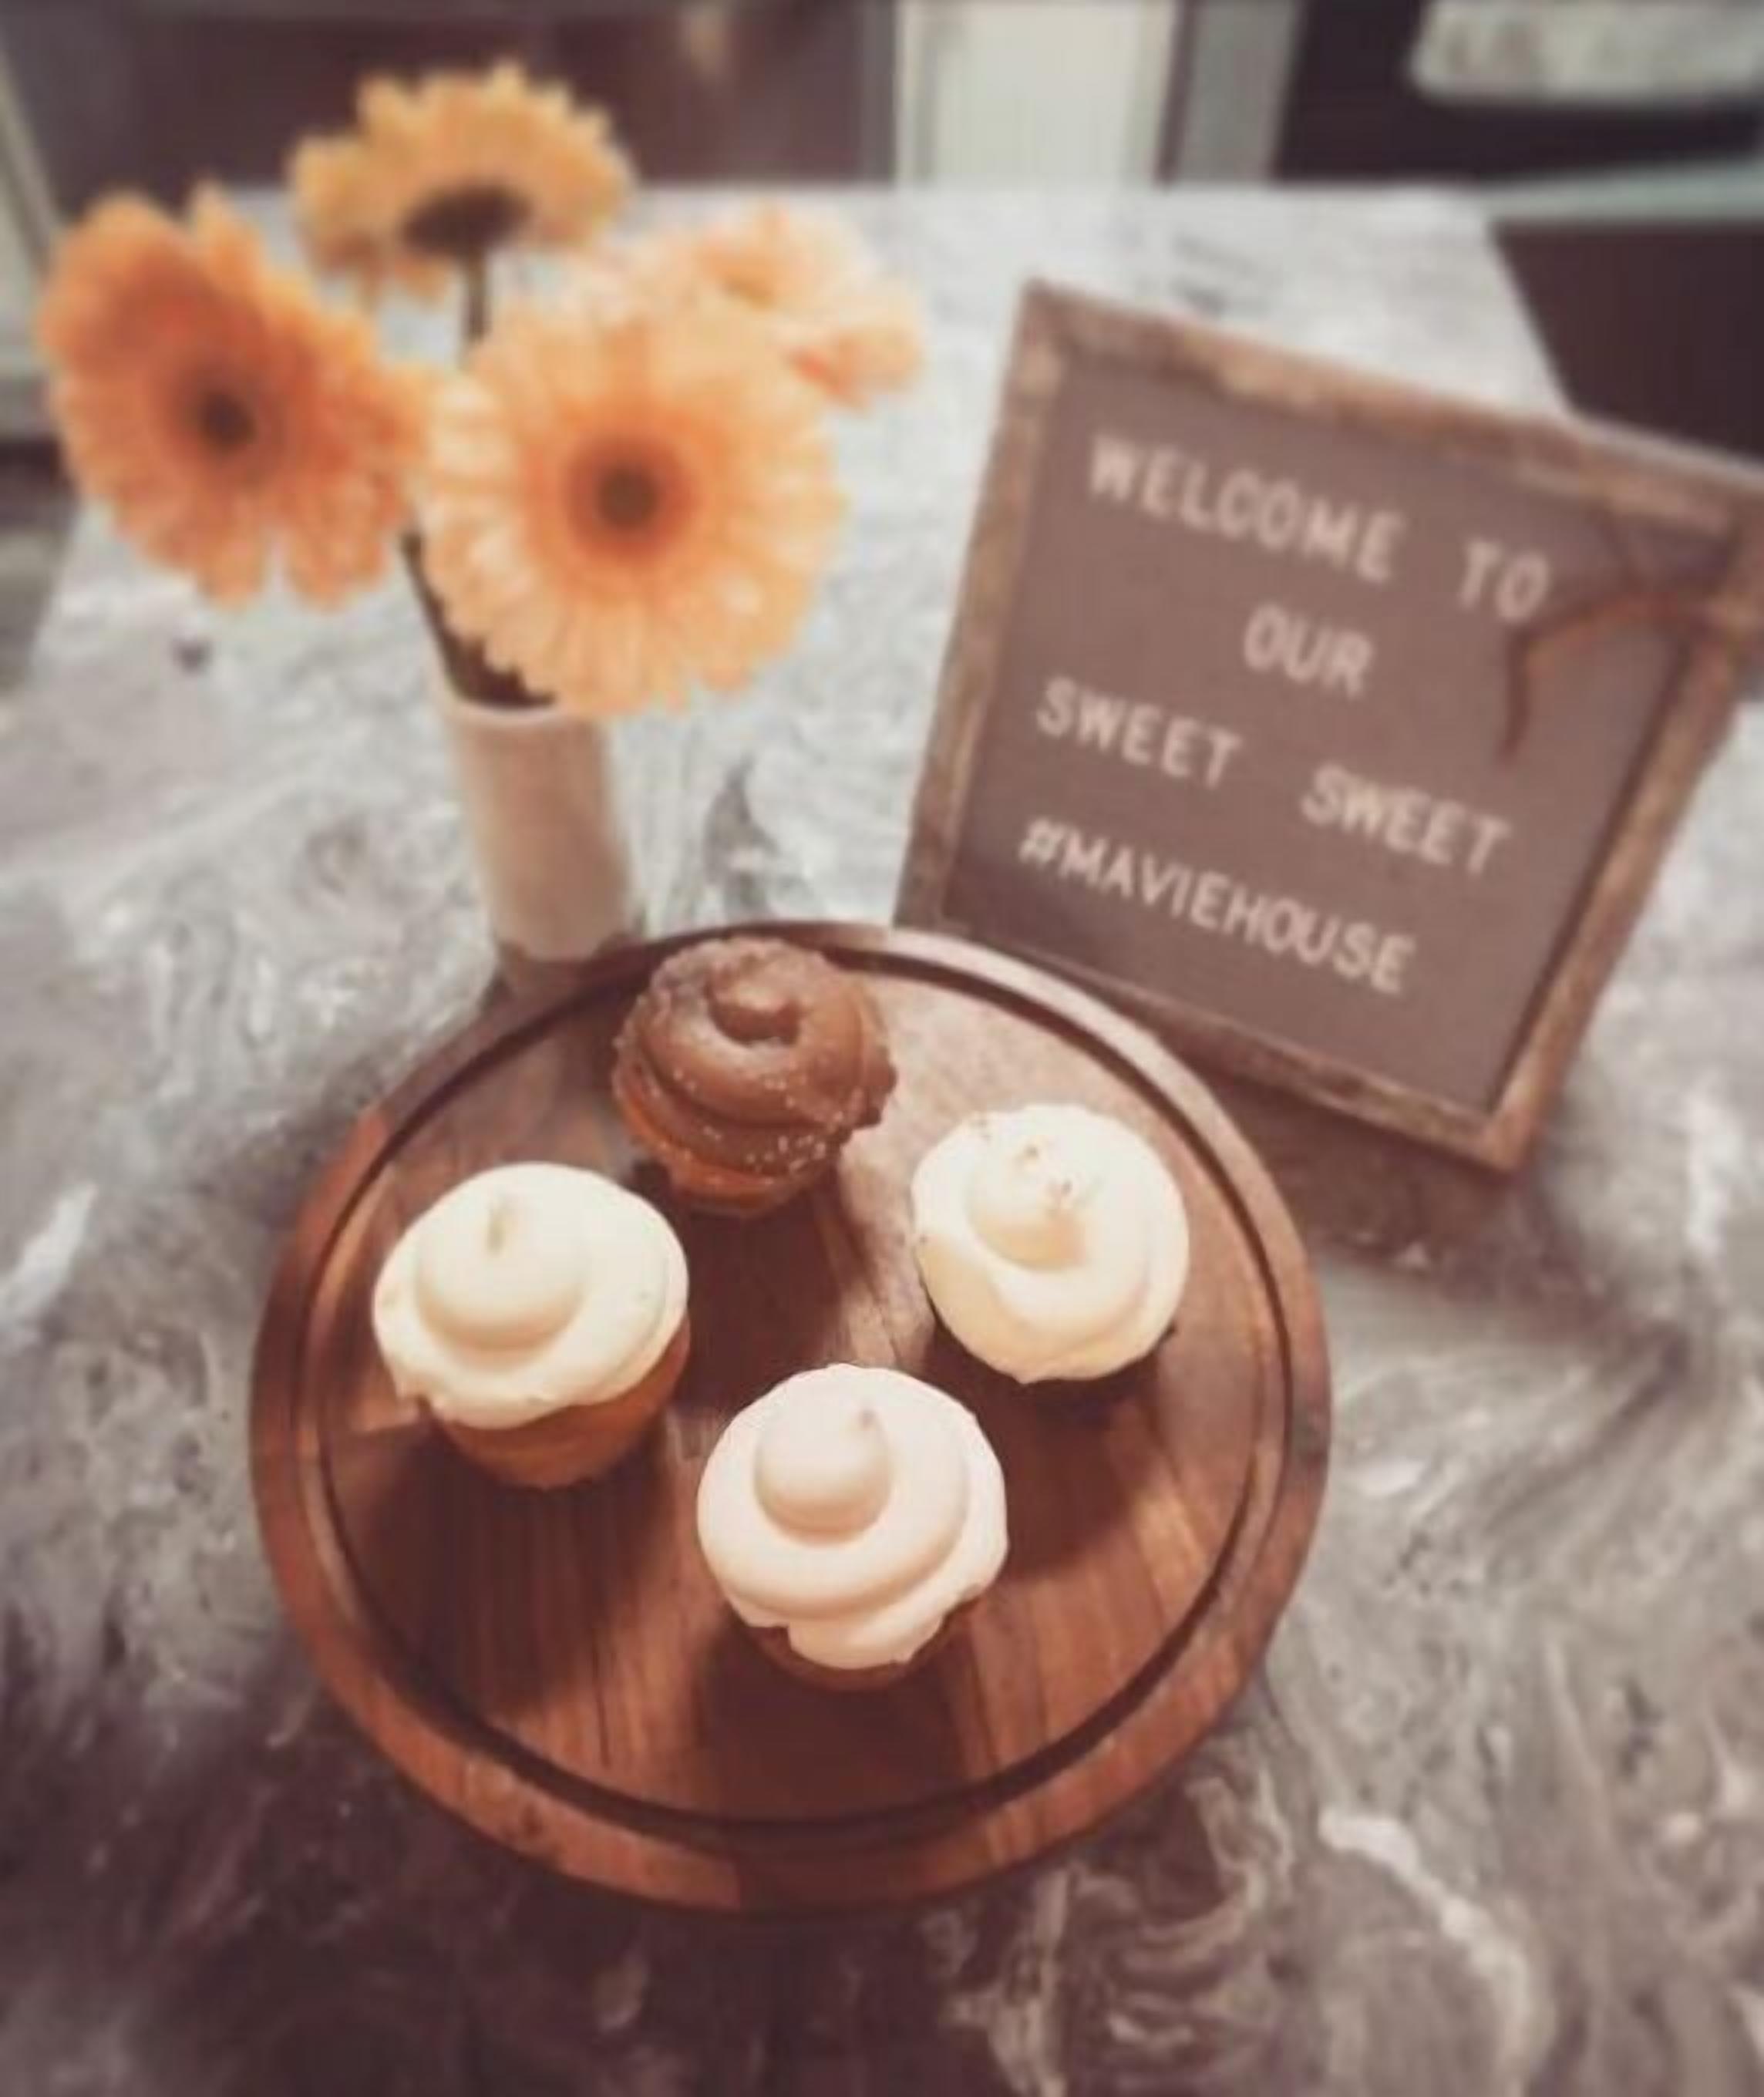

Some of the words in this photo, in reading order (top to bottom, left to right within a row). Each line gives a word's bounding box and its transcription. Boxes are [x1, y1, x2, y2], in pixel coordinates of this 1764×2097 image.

[1089, 434, 1405, 584] WELCOME
[1458, 537, 1550, 621] TO
[1243, 604, 1375, 697] OUR
[1035, 677, 1243, 789] SWEET
[1300, 762, 1511, 875] SWEET
[1018, 818, 1417, 997] #MAVIEHOUSE
